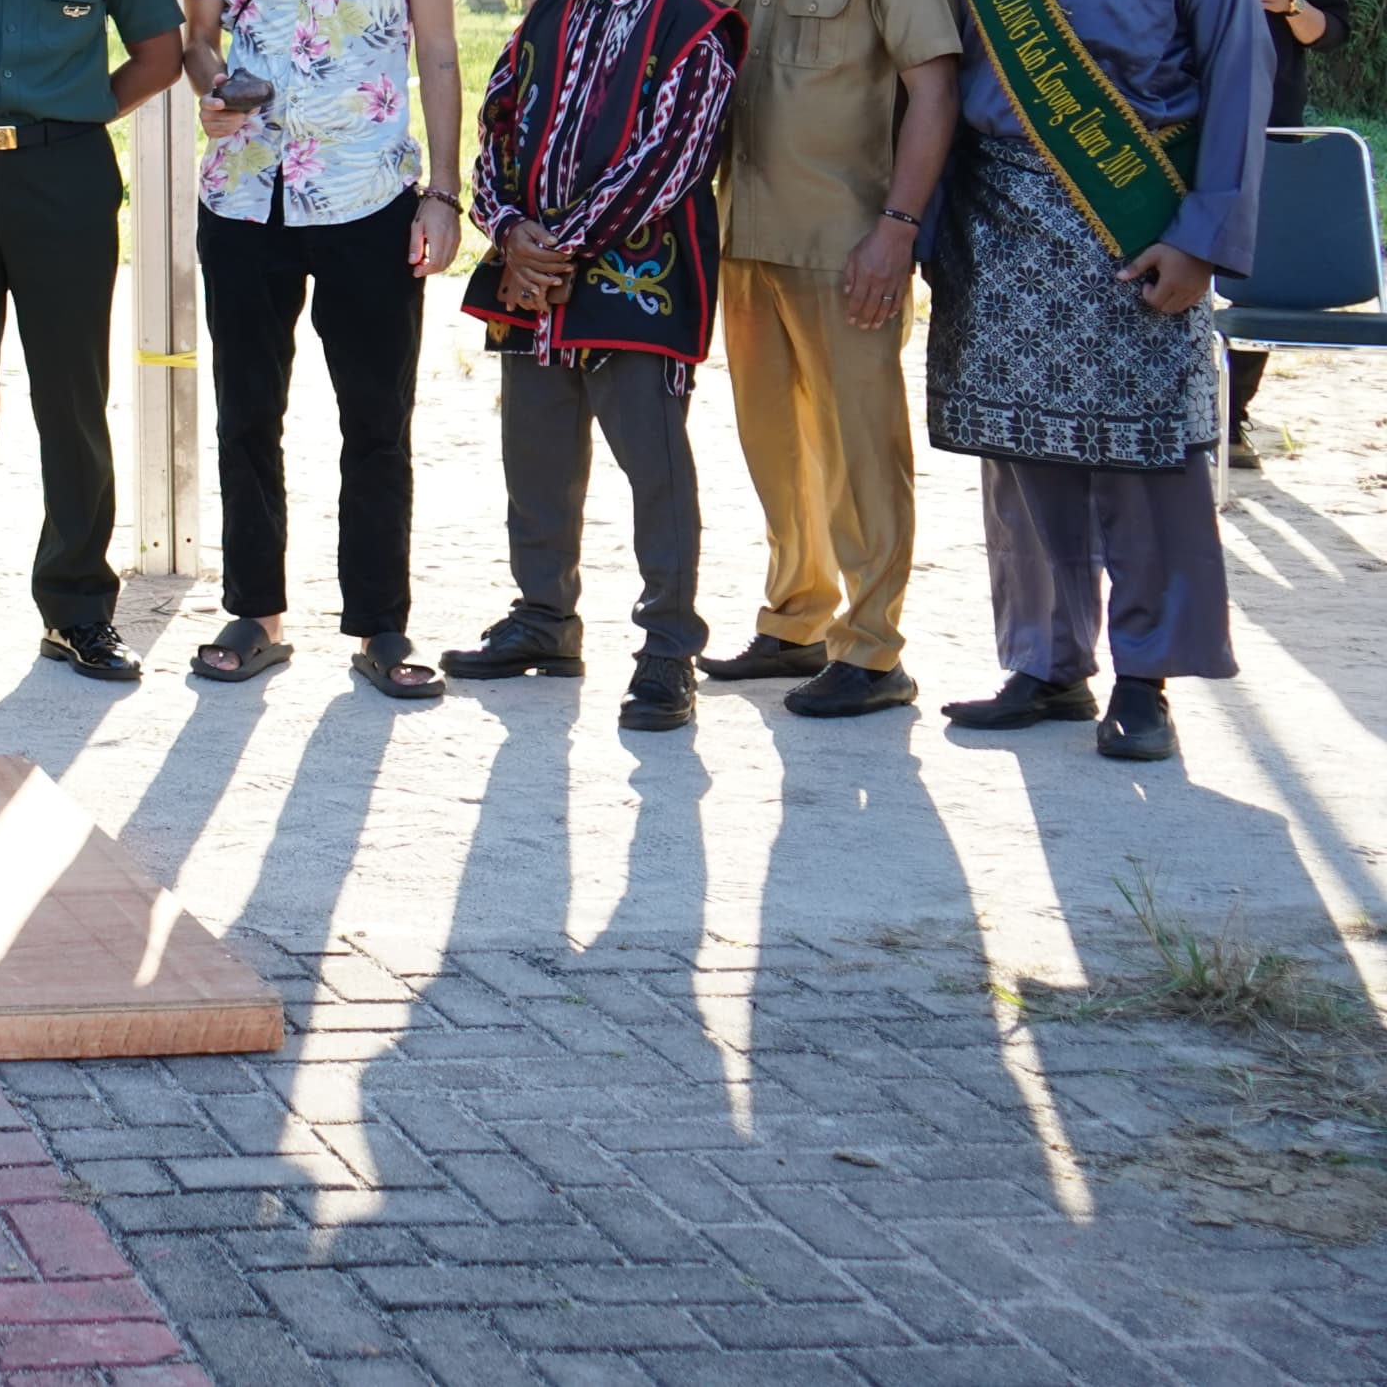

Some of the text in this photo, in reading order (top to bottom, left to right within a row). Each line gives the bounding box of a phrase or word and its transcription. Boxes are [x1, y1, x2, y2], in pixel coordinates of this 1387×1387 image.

[1032, 61, 1082, 127] Kayong
[1069, 107, 1112, 158] Utara
[1096, 144, 1147, 189] 2018
